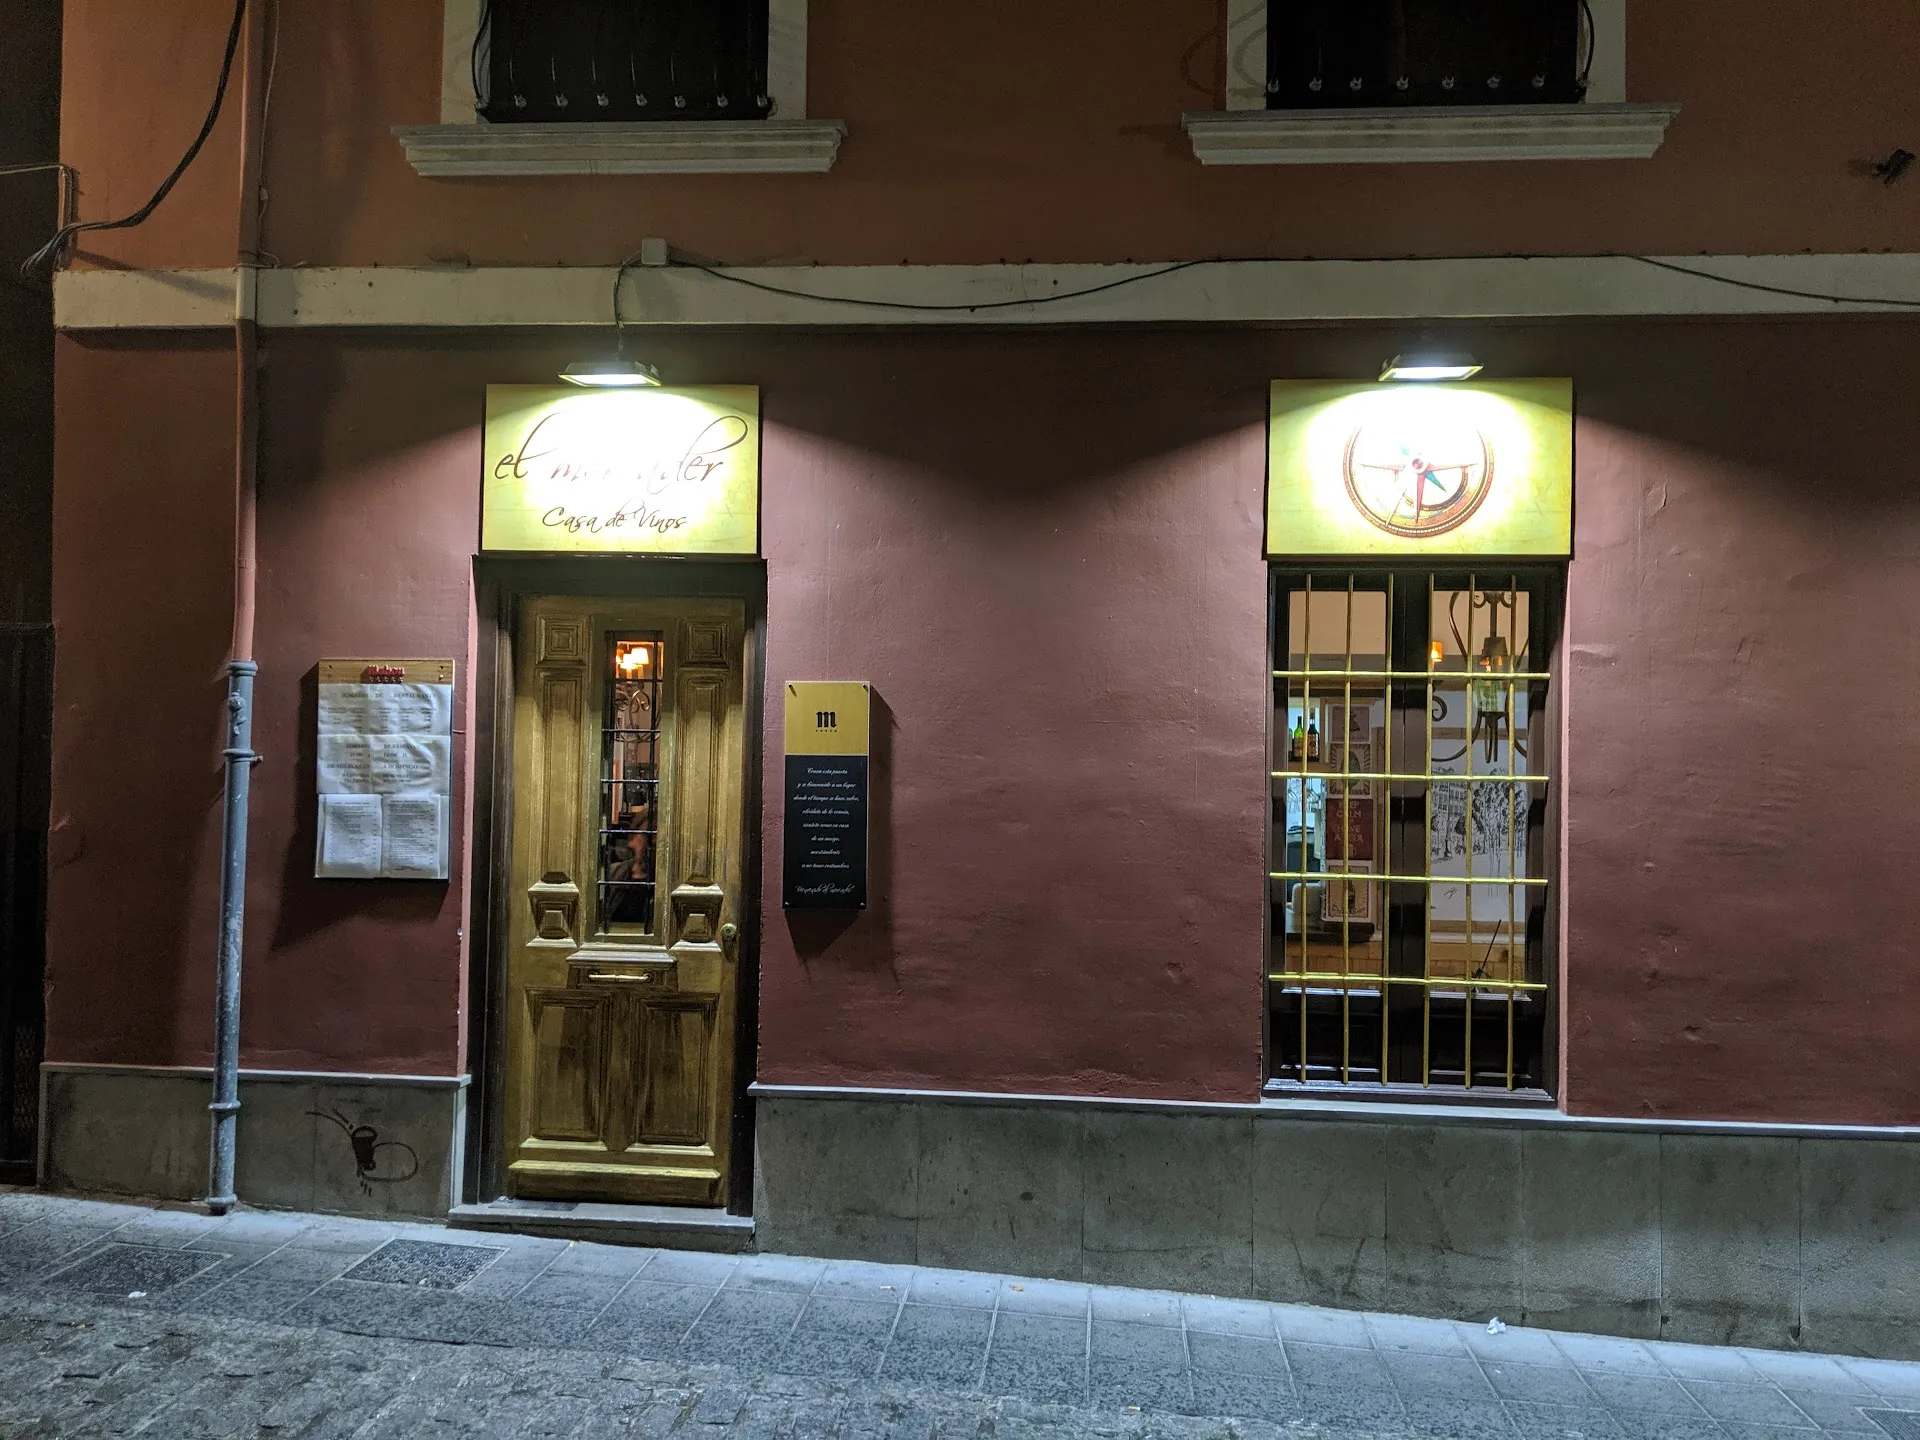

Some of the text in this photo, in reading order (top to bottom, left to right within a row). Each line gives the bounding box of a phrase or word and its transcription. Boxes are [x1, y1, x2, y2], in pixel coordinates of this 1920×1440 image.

[494, 412, 558, 479] el
[542, 498, 687, 533] Casa de Vinos
[816, 711, 837, 728] m
[1338, 801, 1360, 809] KEP
[1336, 810, 1362, 818] CLM
[1338, 824, 1360, 833] HVE
